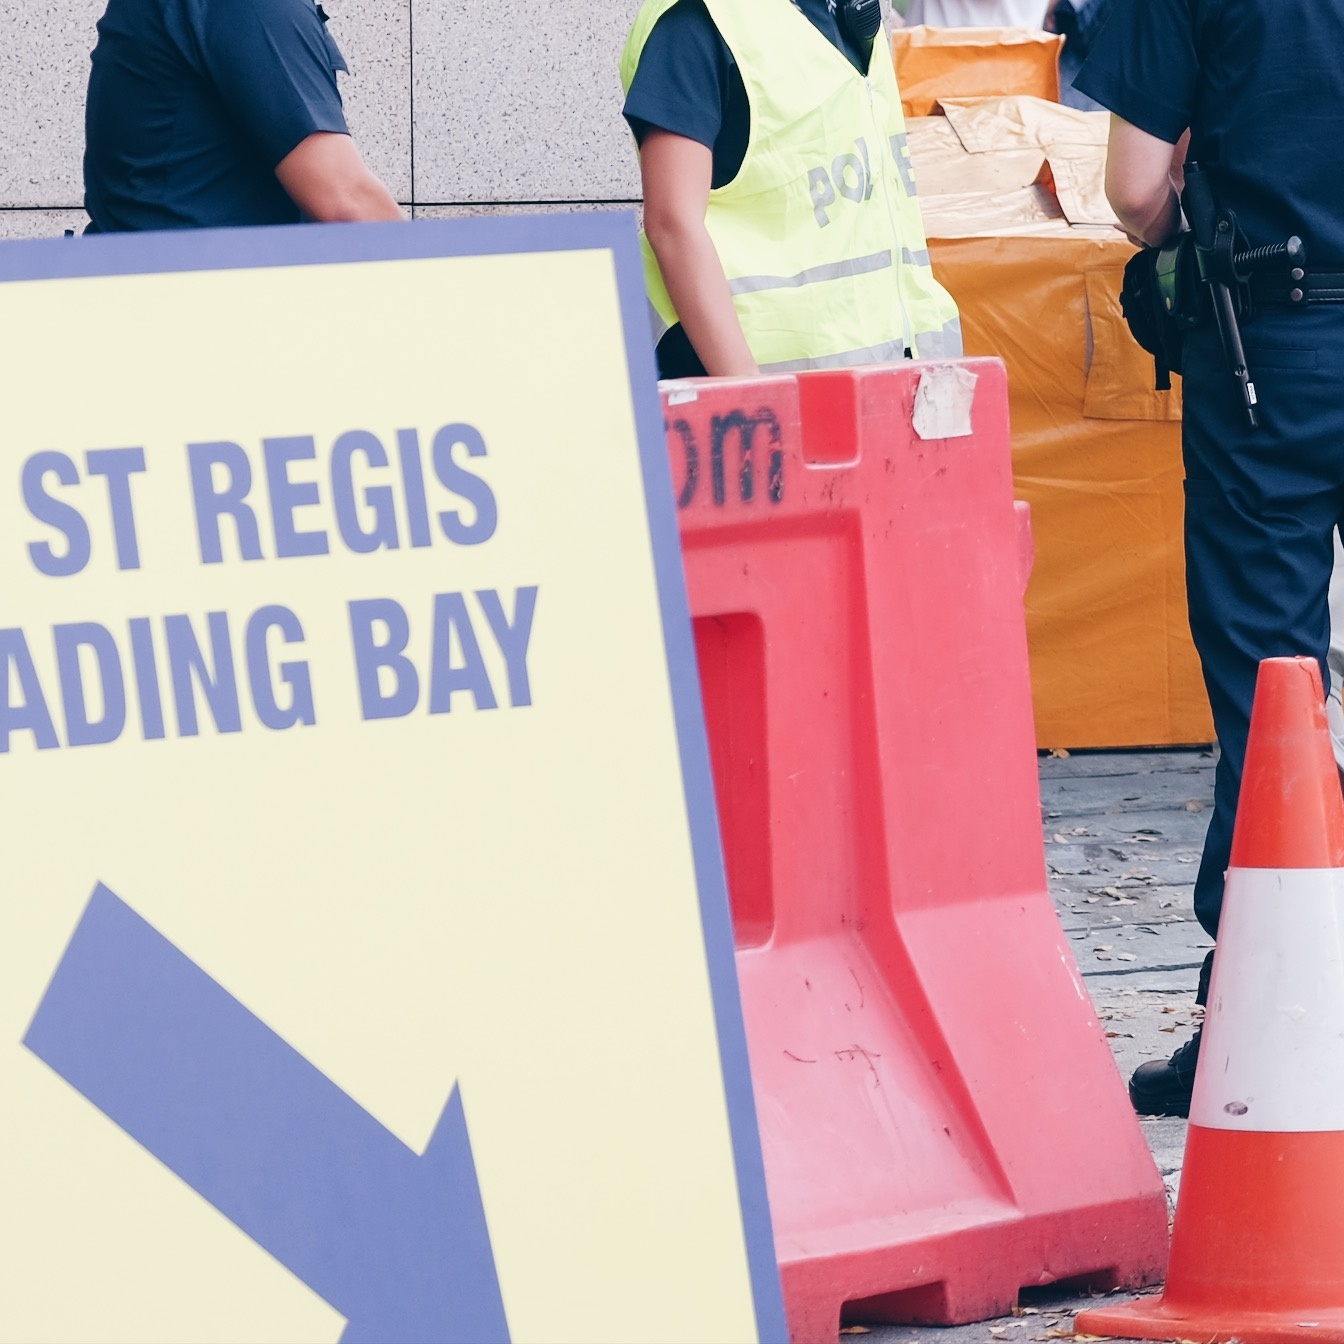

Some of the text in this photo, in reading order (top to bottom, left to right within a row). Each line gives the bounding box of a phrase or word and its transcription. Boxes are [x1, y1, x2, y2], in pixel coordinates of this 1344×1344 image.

[20, 446, 147, 578] ST
[186, 421, 499, 566] REGIS
[348, 584, 540, 722] BAY
